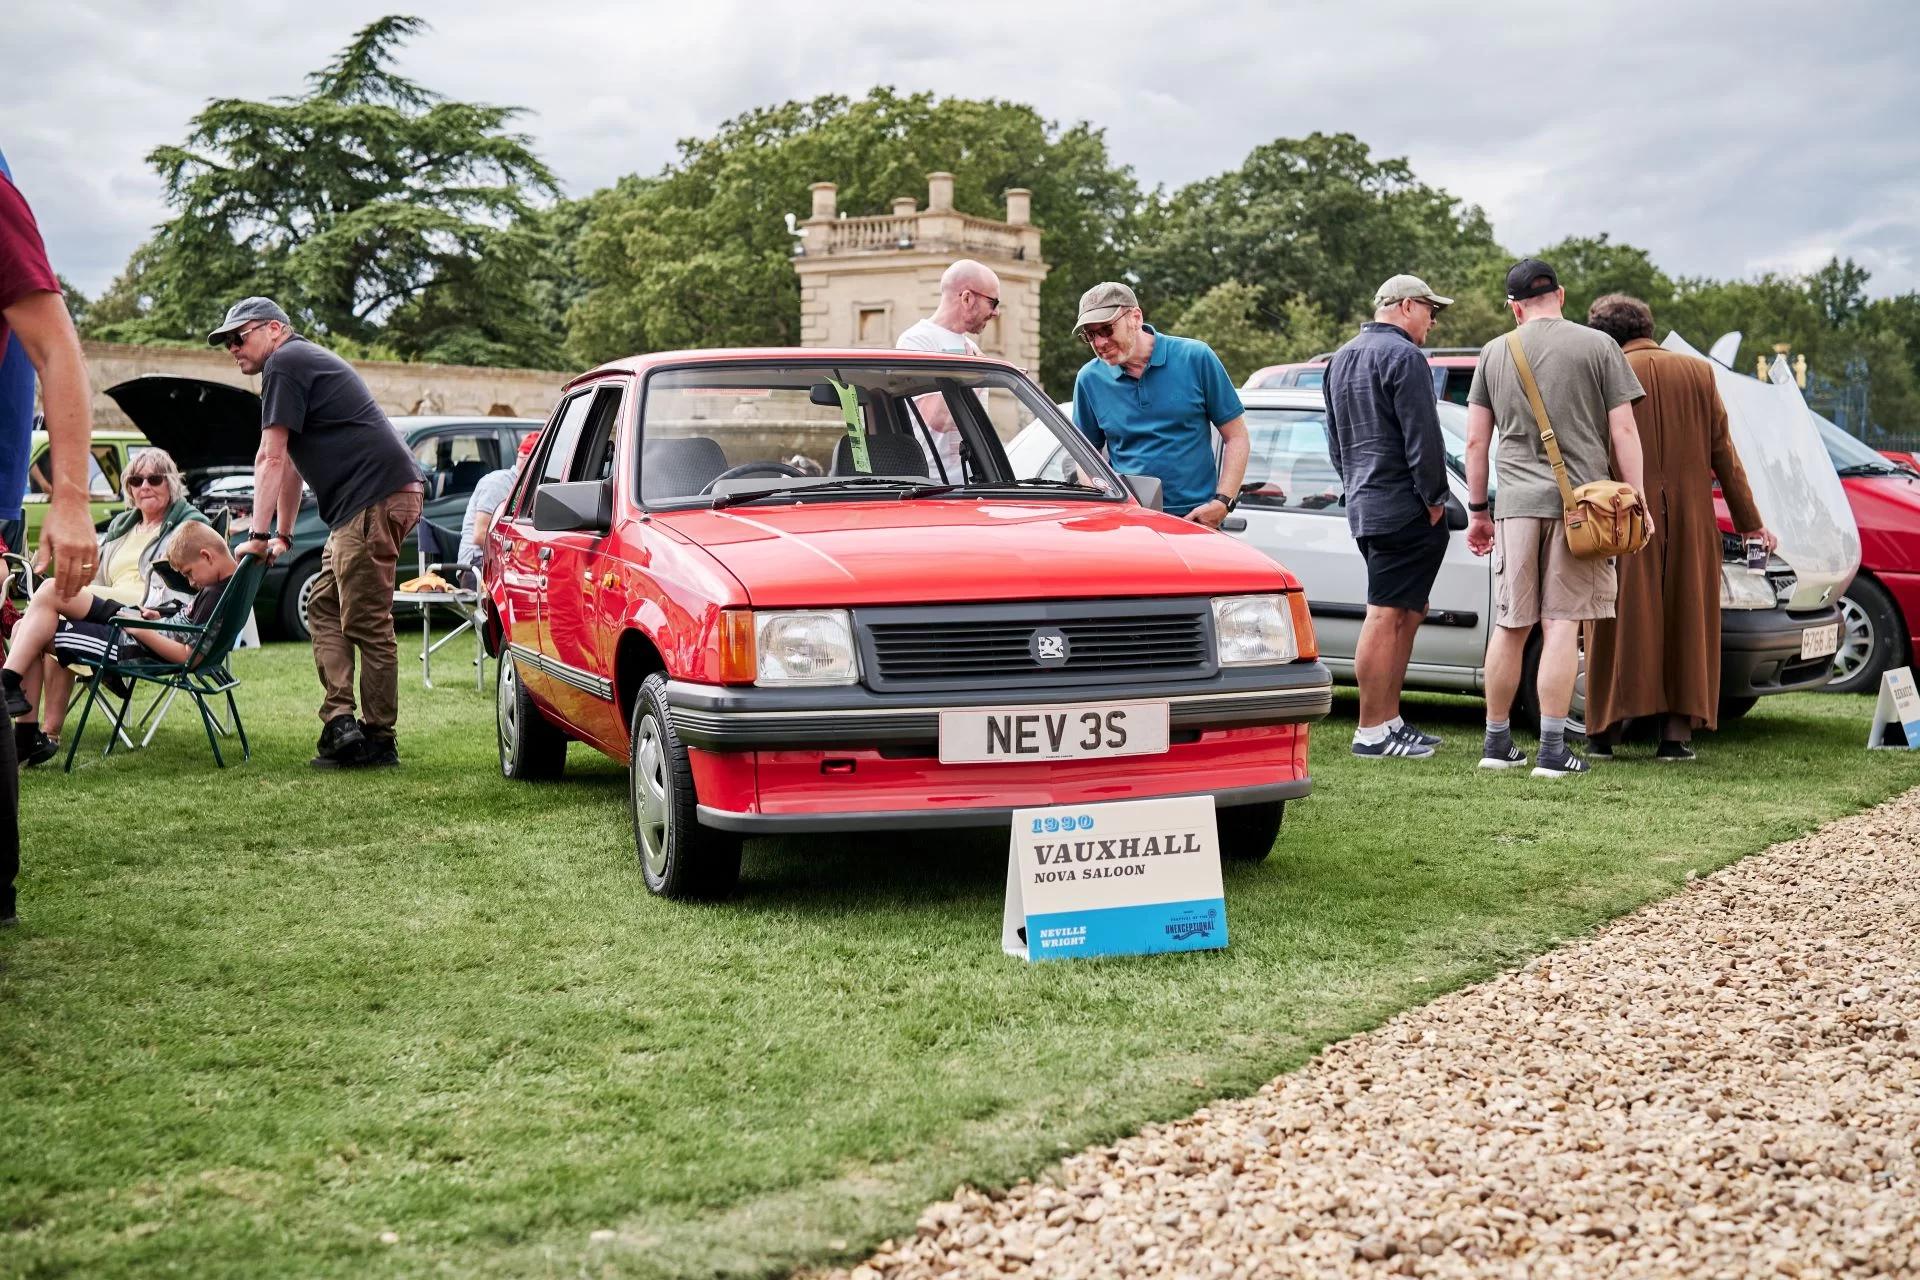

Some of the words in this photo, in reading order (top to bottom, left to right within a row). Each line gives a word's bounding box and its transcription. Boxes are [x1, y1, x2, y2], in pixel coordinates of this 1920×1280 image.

[987, 714, 1067, 754] NEV
[1079, 711, 1127, 750] 3S
[1031, 814, 1094, 833] 1990
[1034, 833, 1201, 866] VAUXHALL
[1034, 870, 1077, 884] NOVA
[1082, 864, 1146, 880] SALOON
[1040, 926, 1087, 938] NEVILLE
[1041, 936, 1086, 948] WRIGHT
